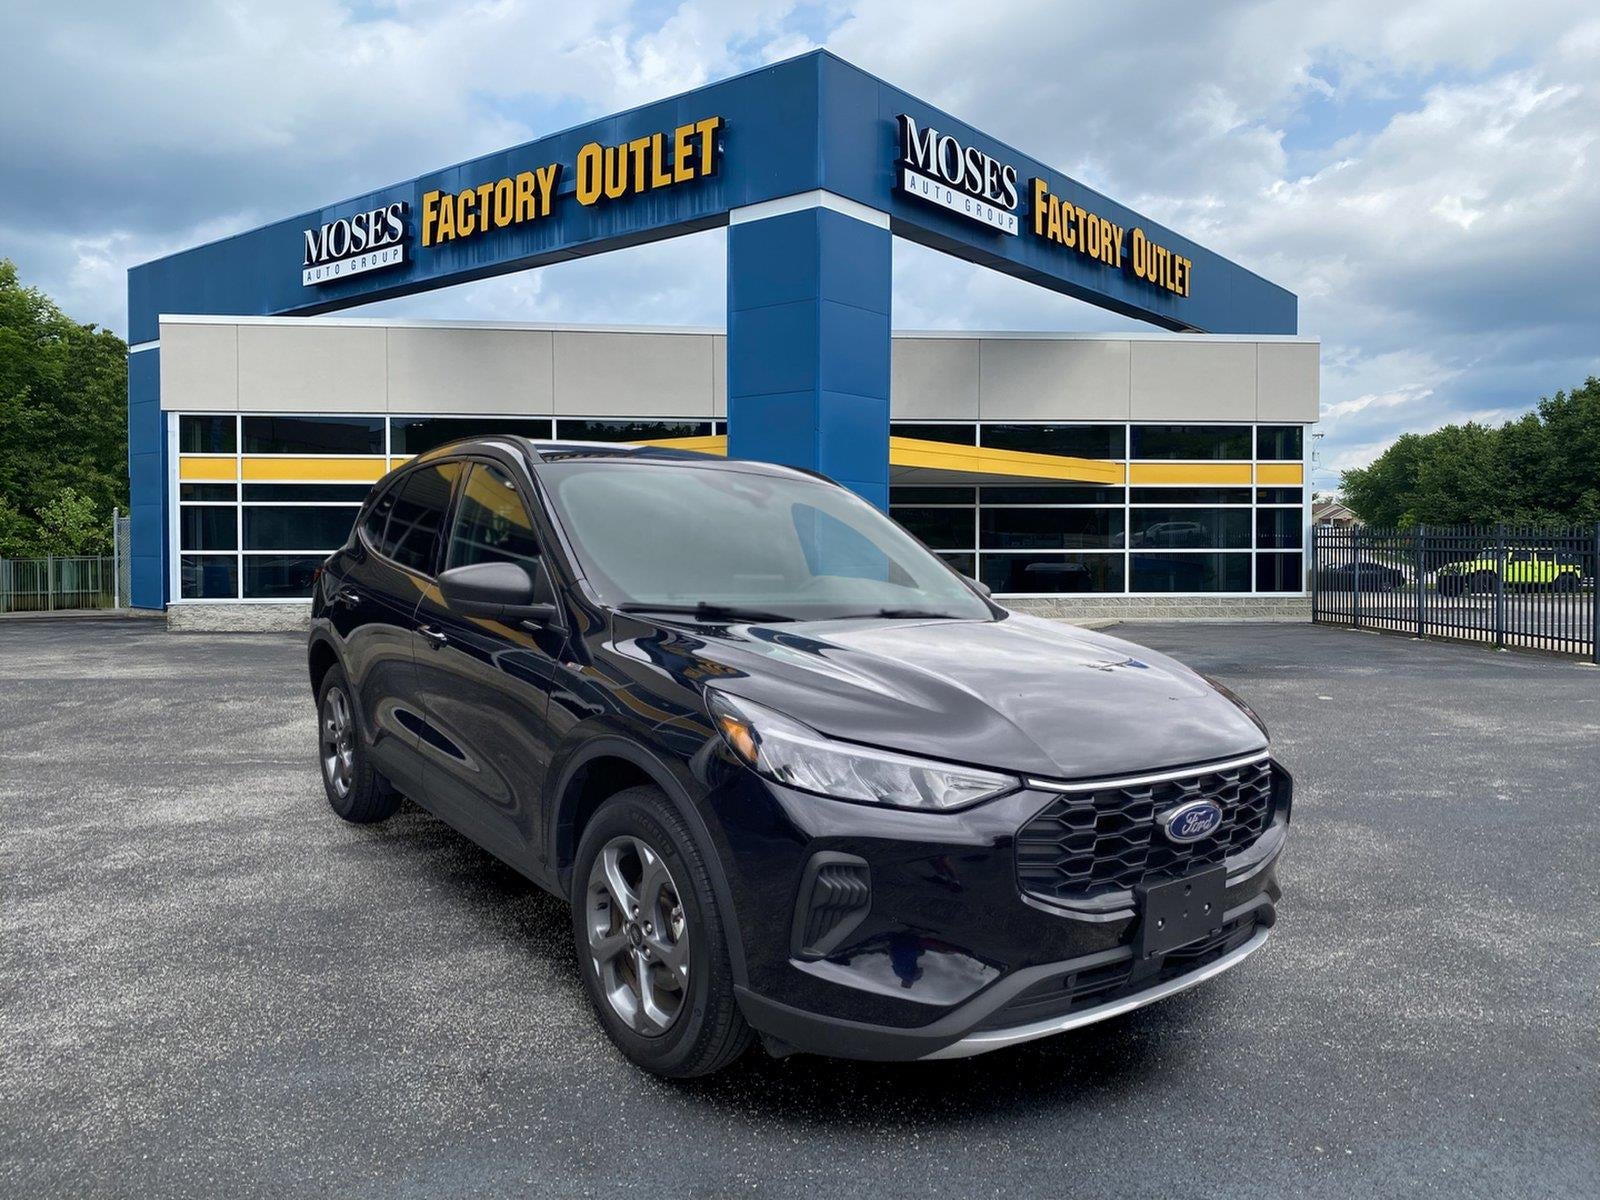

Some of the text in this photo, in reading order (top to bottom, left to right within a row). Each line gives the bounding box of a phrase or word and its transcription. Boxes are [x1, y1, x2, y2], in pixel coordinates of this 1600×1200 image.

[421, 116, 720, 247] FACTORY OUTLET
[904, 114, 1018, 210] MOSES
[303, 201, 404, 265] MOSES
[909, 175, 1014, 230] AUTO GROUP
[306, 250, 400, 282] AUTO GROUP
[1034, 177, 1192, 298] FACTORY OUTLET
[1181, 810, 1214, 835] Ford
